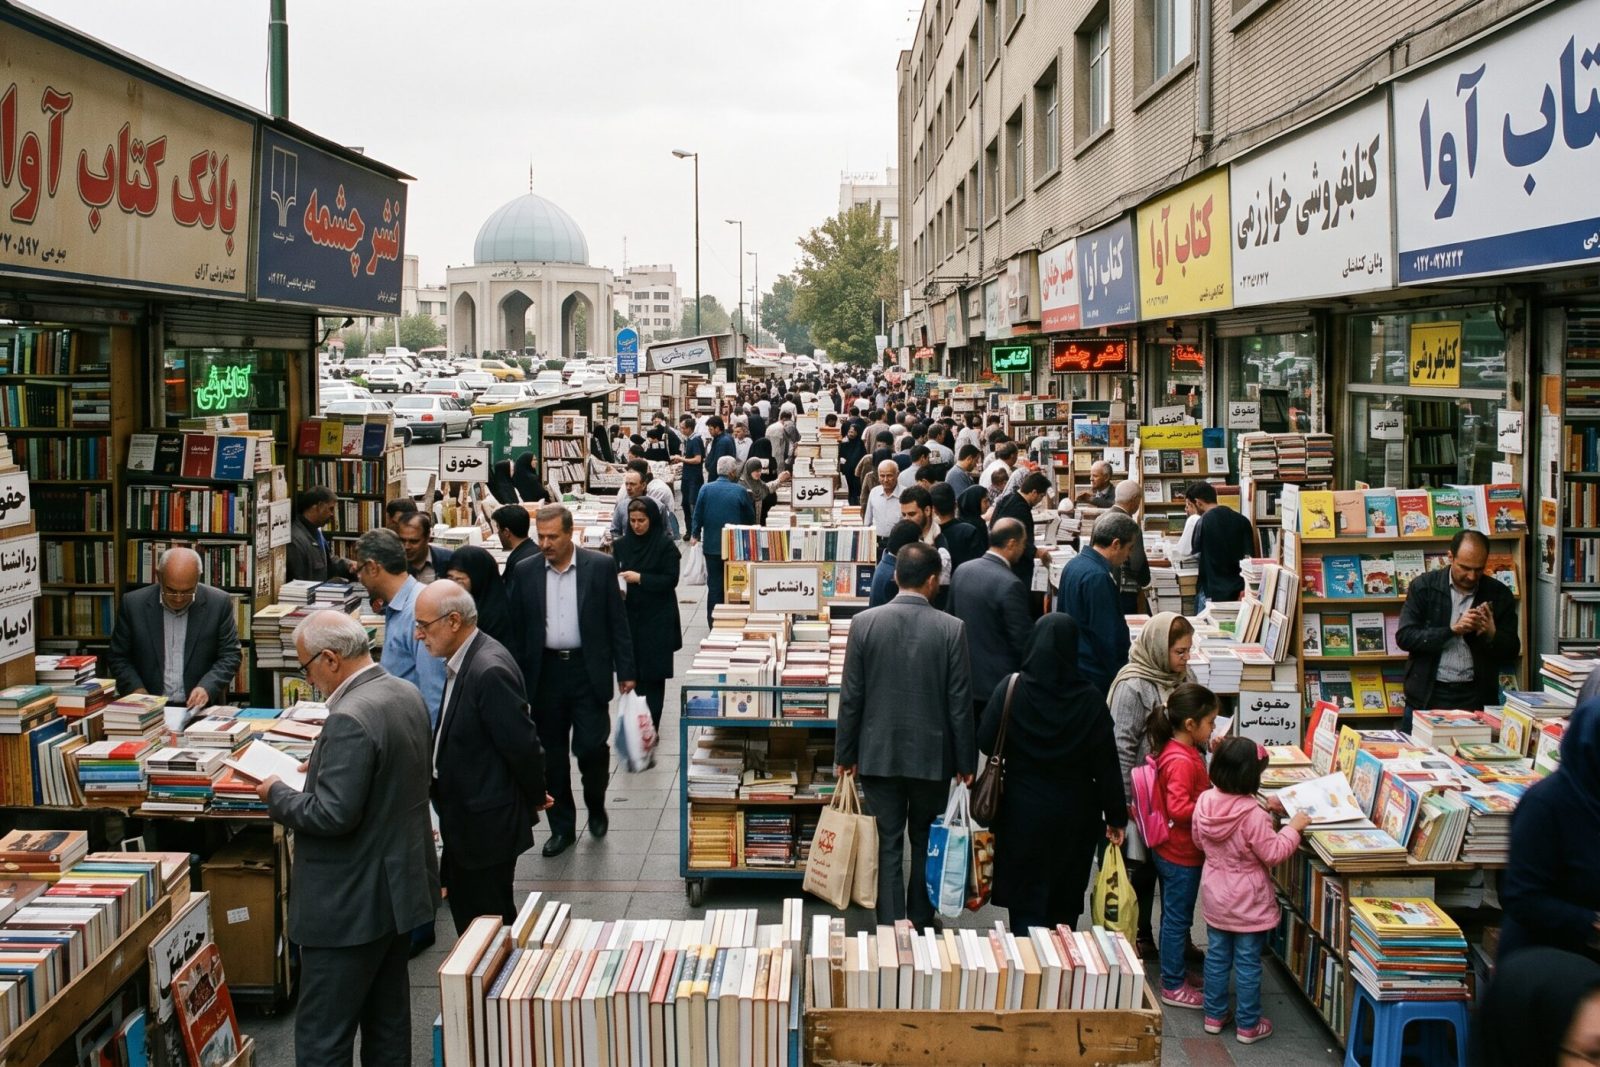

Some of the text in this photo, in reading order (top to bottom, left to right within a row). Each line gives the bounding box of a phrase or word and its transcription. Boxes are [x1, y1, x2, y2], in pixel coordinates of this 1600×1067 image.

[1419, 34, 1600, 220] تاب آوا
[0, 82, 238, 257] بانک کتاب آوا
[1237, 133, 1380, 250] کتابفروشی خوارزمی
[303, 184, 400, 278] نشر چشمه
[1150, 194, 1213, 286] کتاب آوا
[1100, 235, 1124, 297] کتاب
[445, 455, 483, 473] حقوق
[0, 485, 26, 520] حقو
[796, 484, 829, 501] حقوق
[0, 548, 37, 574] روانشنا
[758, 580, 815, 597] روانشناسی
[0, 609, 32, 647] ادبیا
[1240, 716, 1296, 731] روانشناسی
[1250, 698, 1291, 713] حقوق
